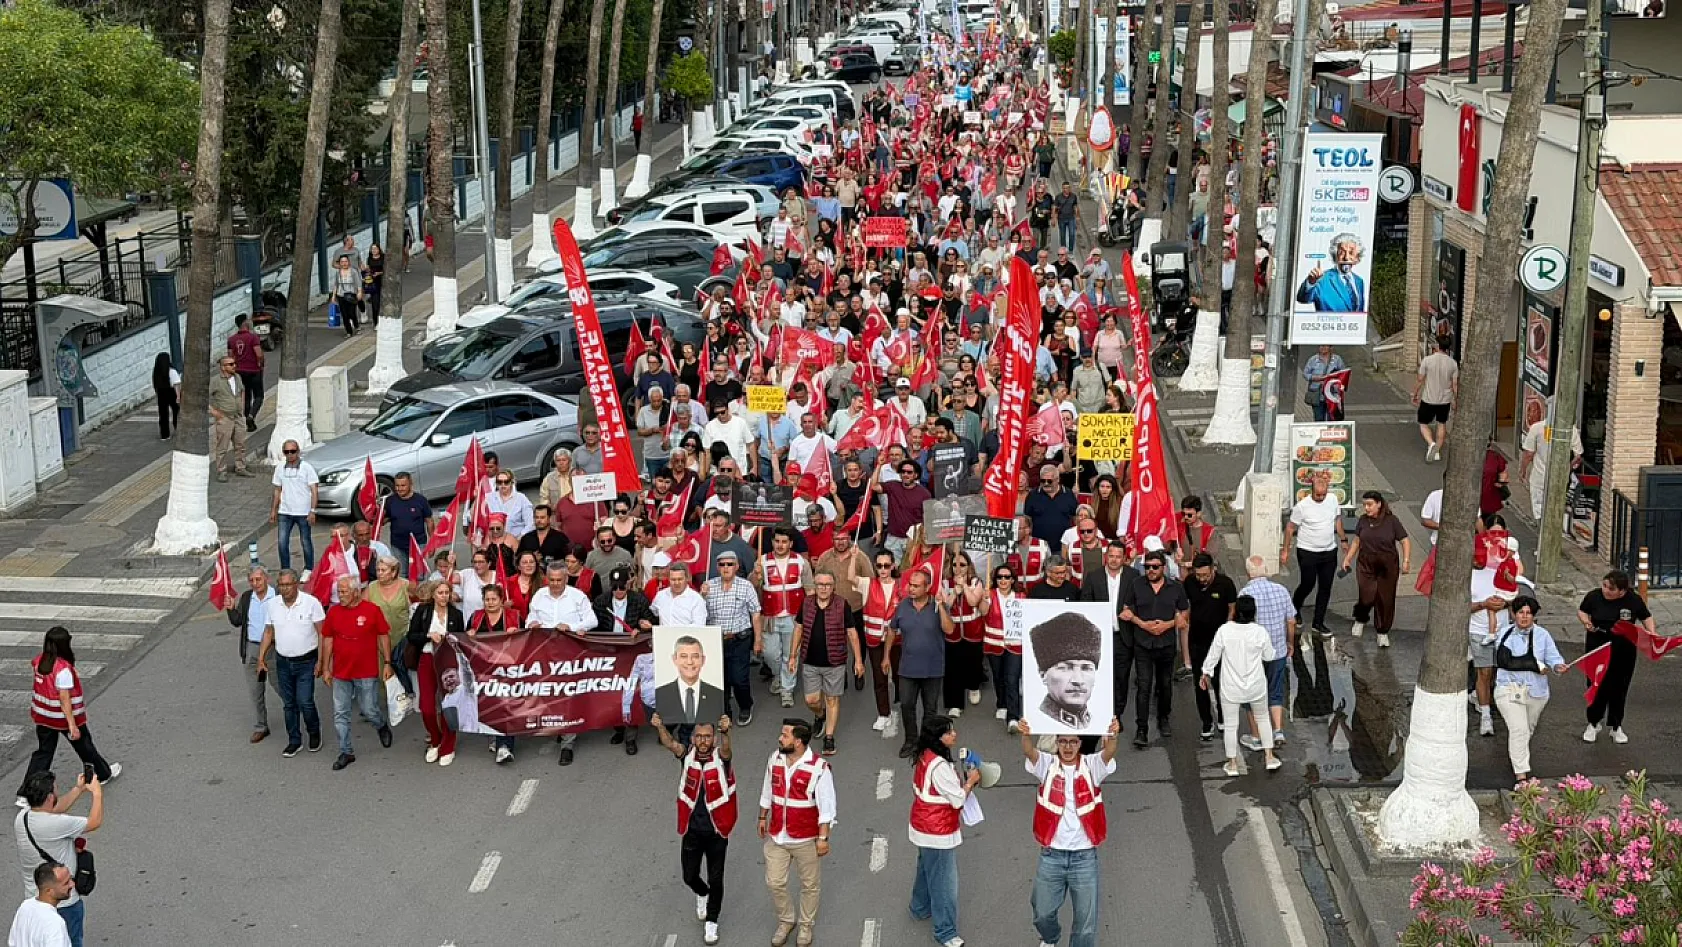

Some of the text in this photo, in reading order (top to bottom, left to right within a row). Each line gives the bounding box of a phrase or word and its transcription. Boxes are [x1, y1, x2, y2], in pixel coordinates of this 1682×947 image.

[1312, 147, 1374, 168] TEOL
[1385, 174, 1405, 194] R
[1314, 189, 1368, 200] 5K Etkisi
[1532, 256, 1558, 282] R
[1300, 322, 1321, 331] 0252
[796, 348, 819, 358] CHP
[1081, 415, 1135, 428] SOKAKTA
[972, 518, 1012, 530] ADALET
[967, 525, 1007, 538] SUSARSA
[970, 535, 994, 544] HALK
[491, 656, 617, 679] ASLA YALNIZ
